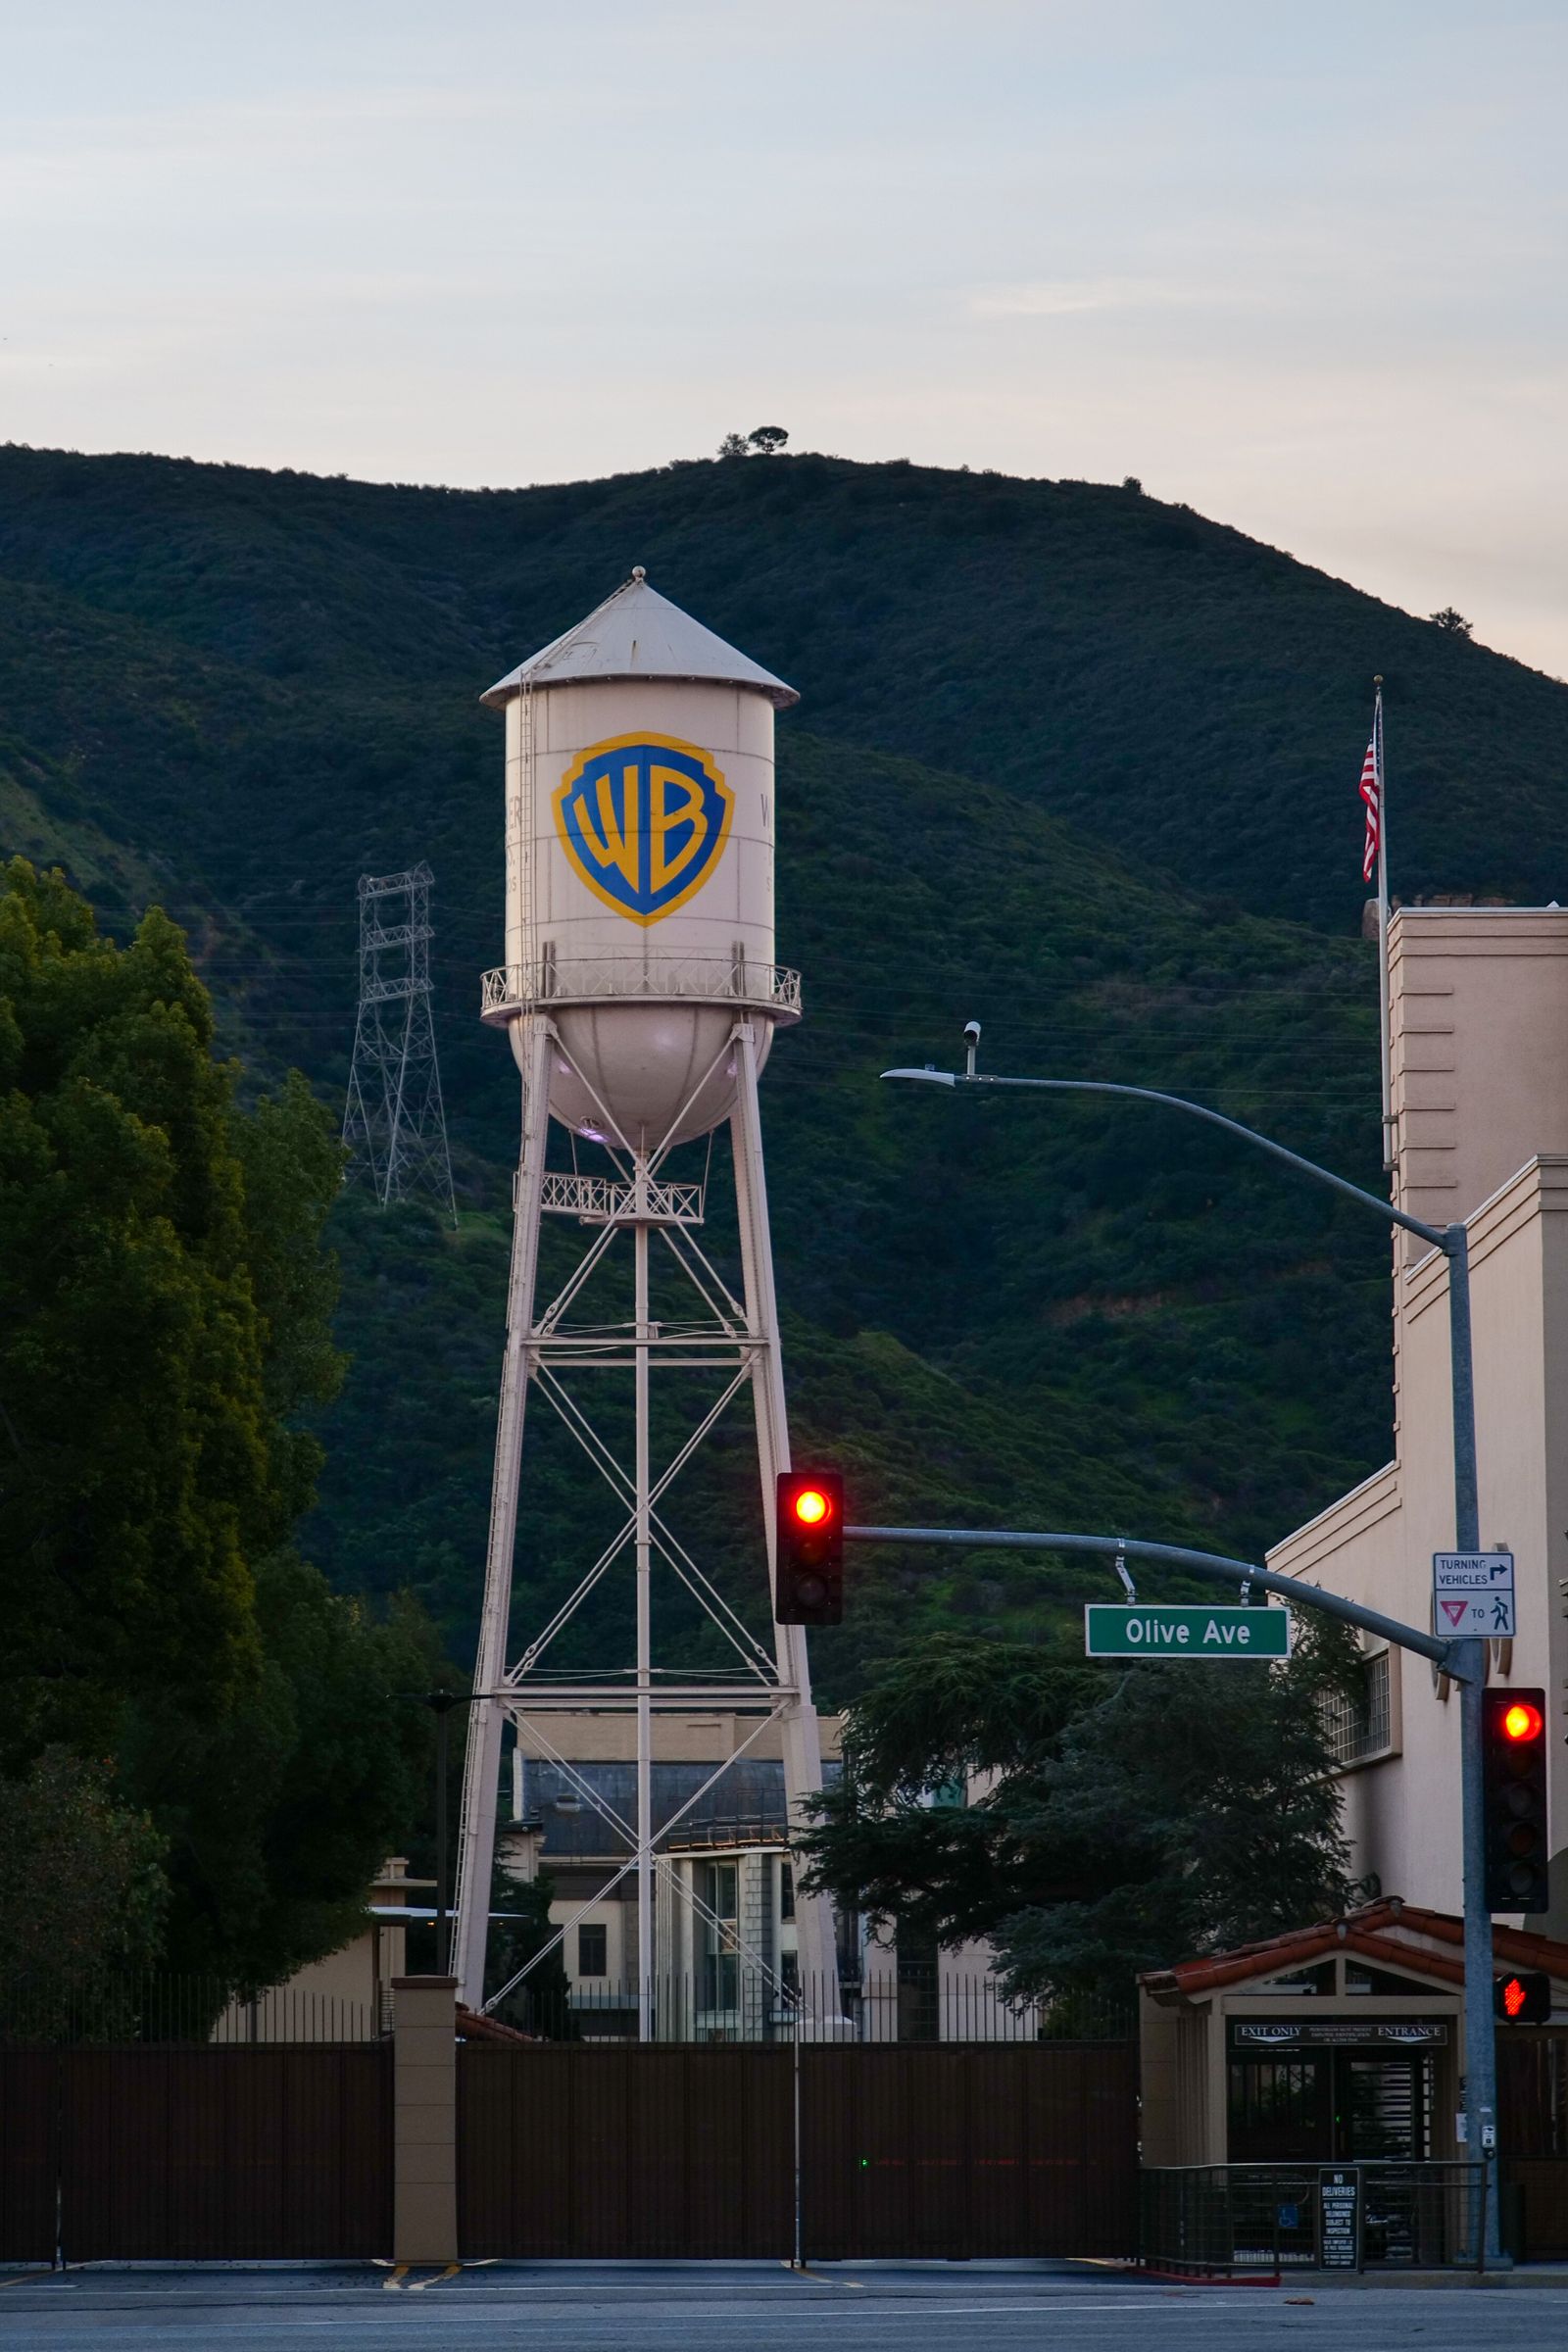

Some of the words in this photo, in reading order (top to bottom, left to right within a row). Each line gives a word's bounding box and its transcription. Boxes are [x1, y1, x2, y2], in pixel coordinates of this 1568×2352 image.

[572, 764, 708, 895] WB
[1441, 1559, 1487, 1570] TURNING
[1439, 1575, 1488, 1585] VEHICLES
[1471, 1608, 1485, 1619] TO
[1125, 1618, 1190, 1644] Olive
[1202, 1619, 1250, 1644] Ave
[1241, 2027, 1270, 2036] EXIT
[1271, 2027, 1301, 2036] ONLY
[1378, 2027, 1442, 2036] ENTRANCE
[1333, 2174, 1344, 2184] NO
[1322, 2186, 1355, 2197] DELIVERIES
